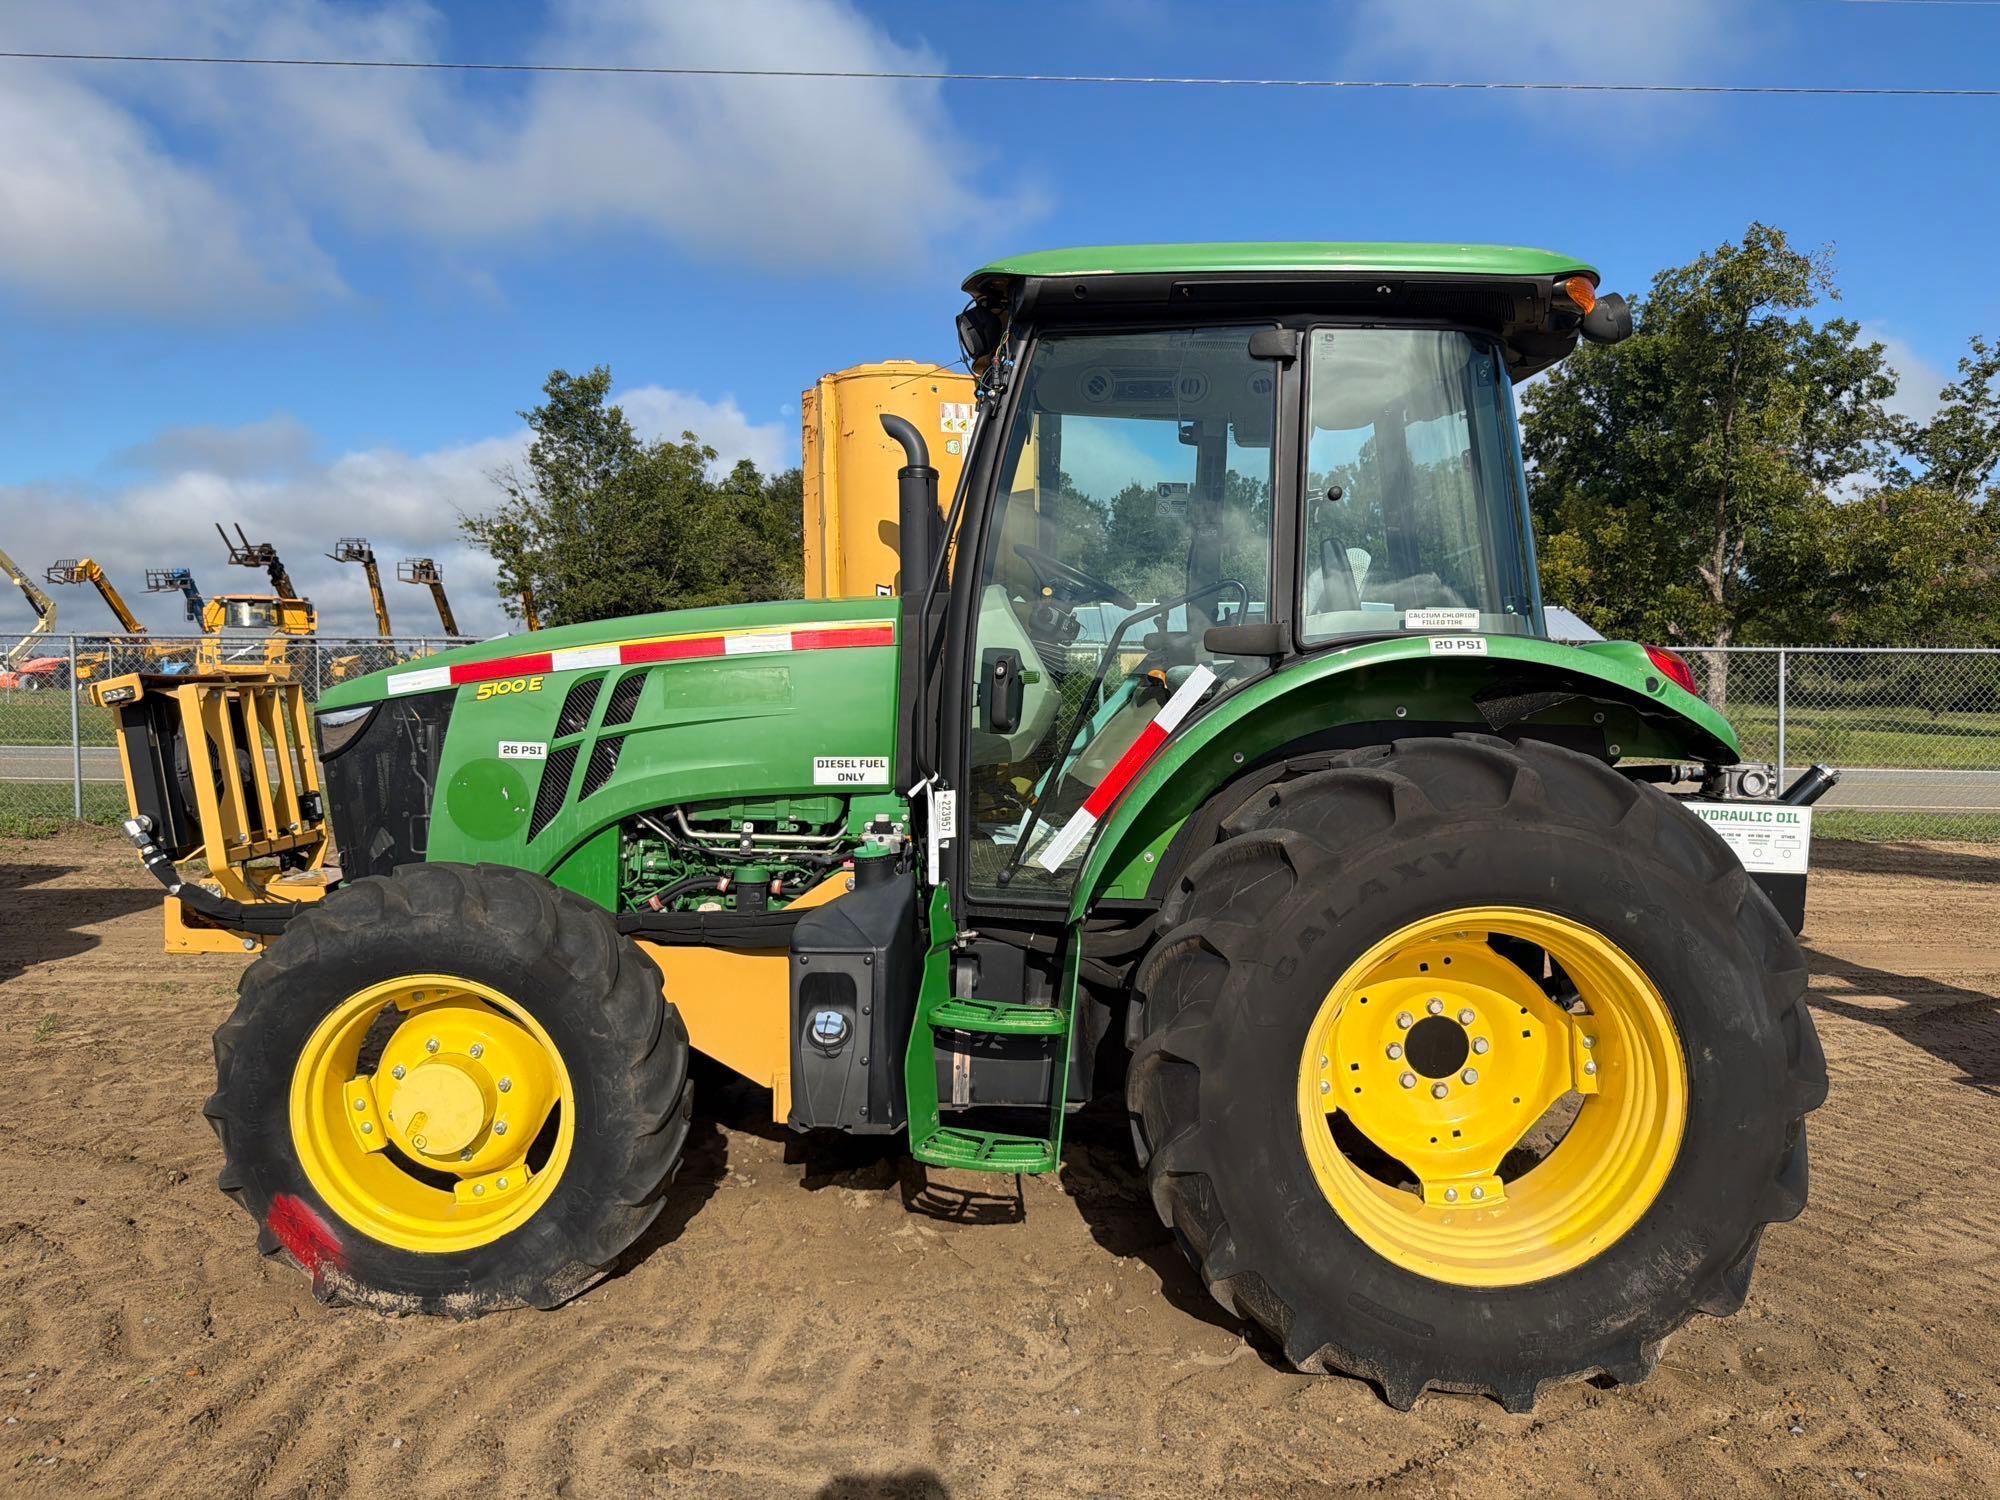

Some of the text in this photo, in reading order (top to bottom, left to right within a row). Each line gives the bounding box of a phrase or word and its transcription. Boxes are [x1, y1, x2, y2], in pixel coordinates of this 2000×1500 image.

[1434, 640, 1482, 650] 20 PSI
[502, 745, 543, 755] 26 PSI
[817, 759, 886, 769] DIESEL FUEL
[837, 772, 865, 782] ONLY
[941, 800, 952, 832] 223957
[1776, 811, 1801, 824] OIL
[1271, 847, 1468, 985] GALAXY
